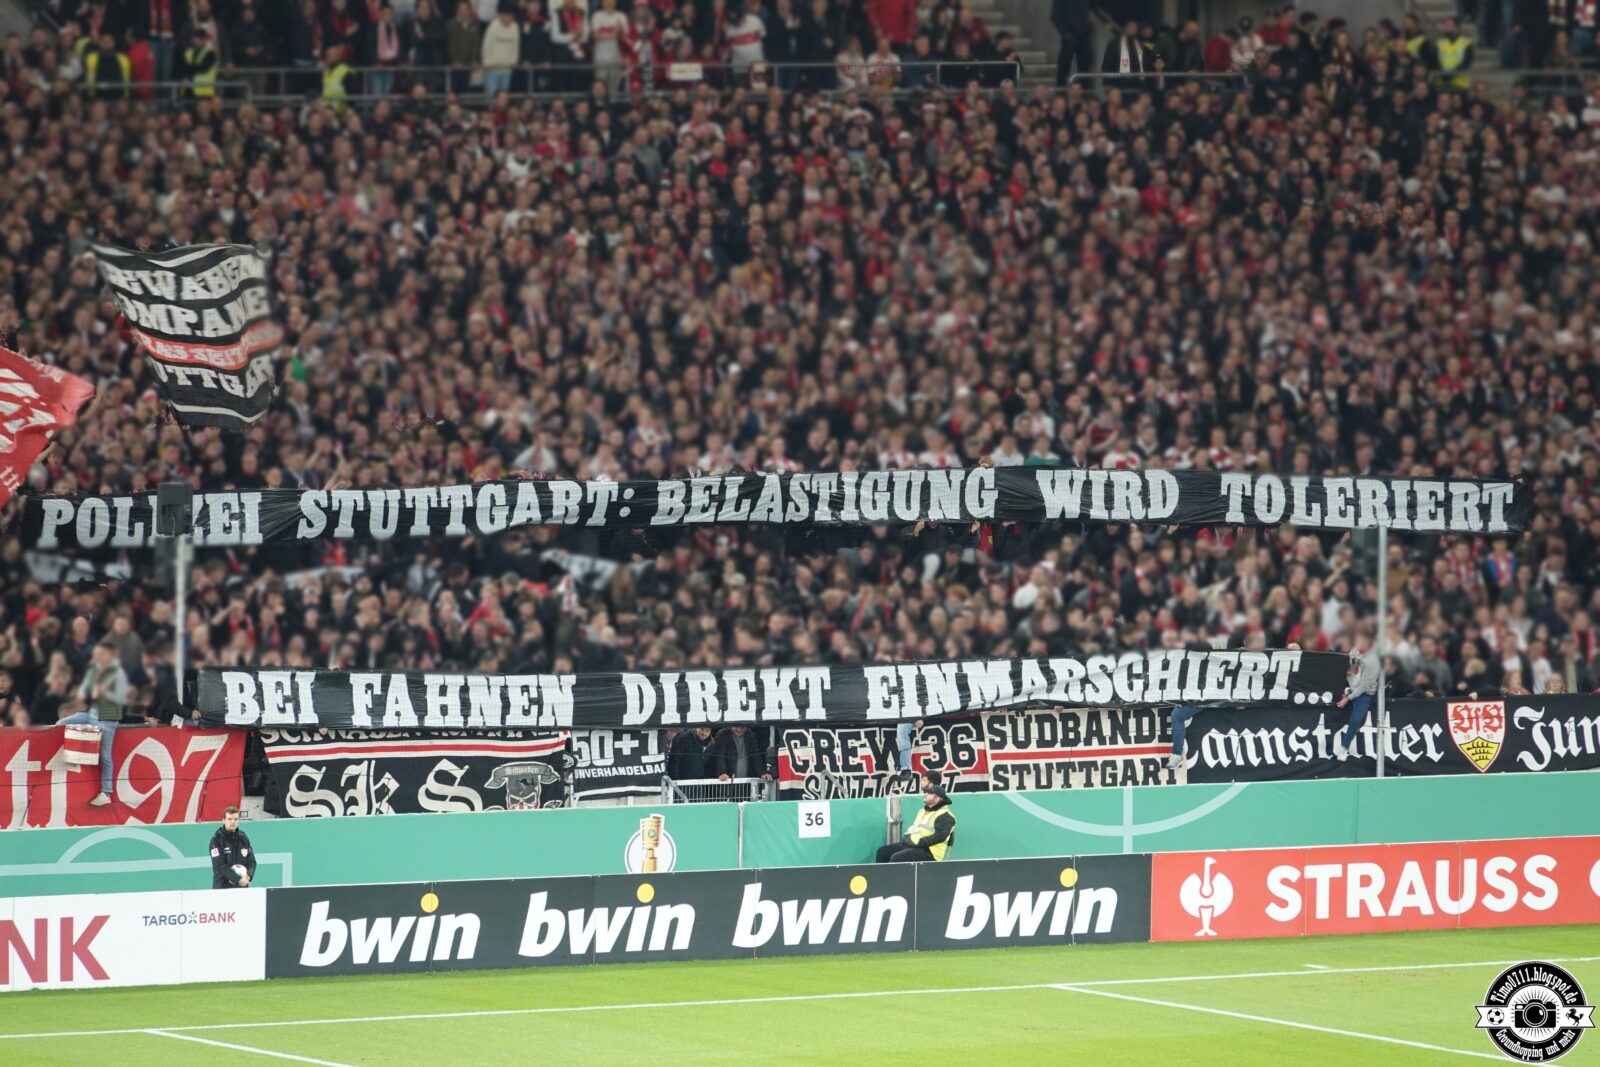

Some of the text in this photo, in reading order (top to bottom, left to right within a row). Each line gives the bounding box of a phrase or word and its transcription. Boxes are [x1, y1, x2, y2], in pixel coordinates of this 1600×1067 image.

[296, 481, 635, 539] STUTTGART:
[1036, 469, 1180, 520] WIRD
[1220, 474, 1513, 531] TOLERIERT
[222, 650, 1333, 727] BEI FAHNEN DIREKT EINMARSCHIERT...
[572, 729, 665, 767] 50+1
[920, 722, 978, 771] 36
[804, 812, 825, 827] 36
[518, 883, 696, 957] bwin
[732, 875, 908, 948] bwin
[945, 867, 1118, 940] bwin
[1265, 854, 1559, 922] STRAUSS
[299, 893, 481, 967] bwin
